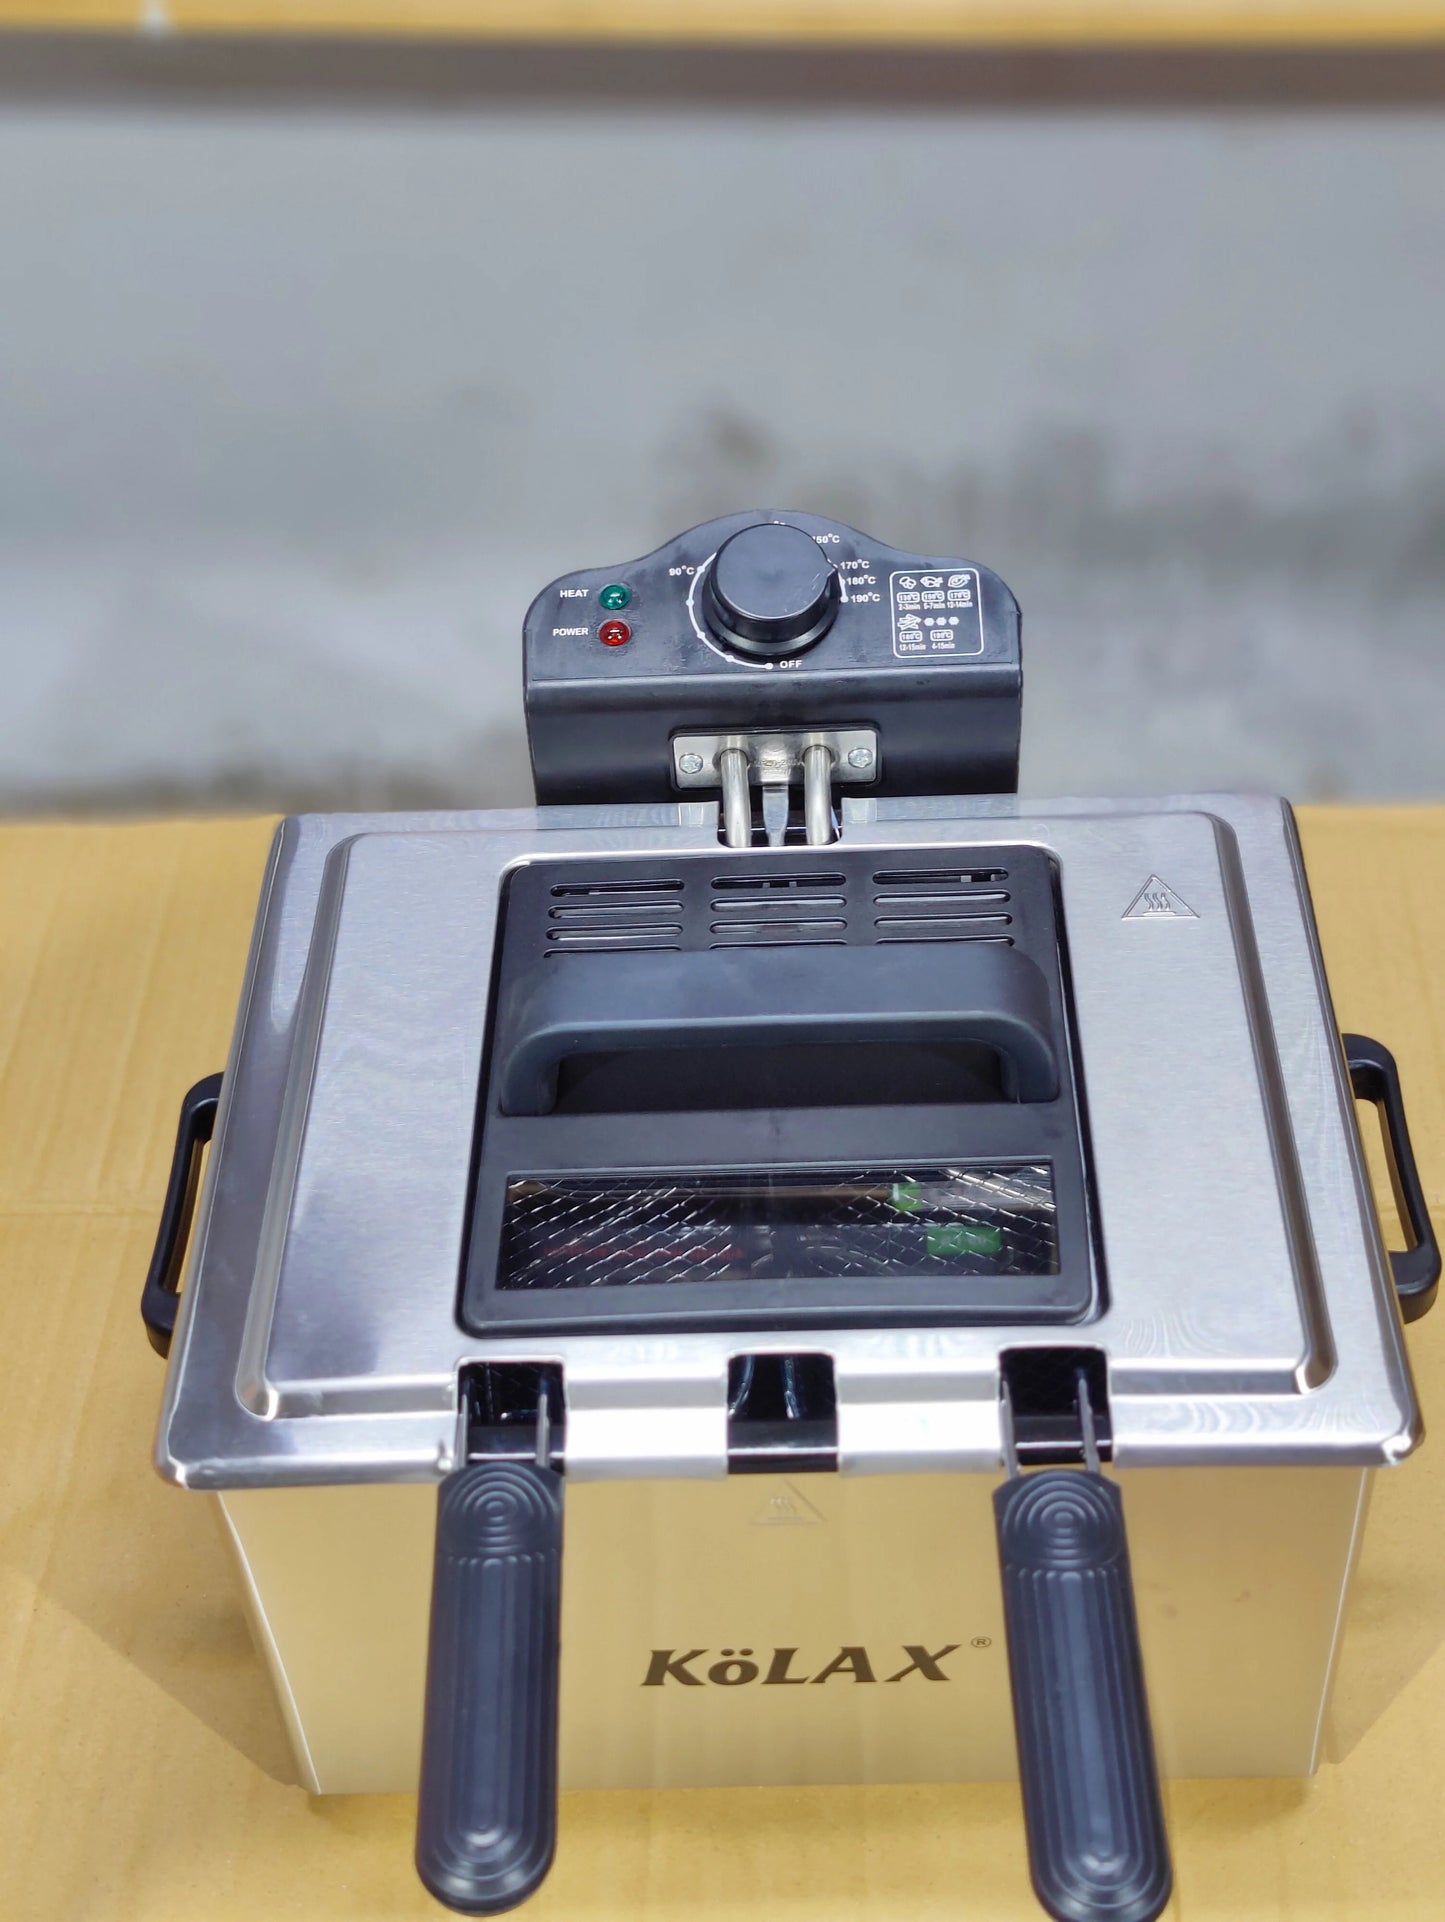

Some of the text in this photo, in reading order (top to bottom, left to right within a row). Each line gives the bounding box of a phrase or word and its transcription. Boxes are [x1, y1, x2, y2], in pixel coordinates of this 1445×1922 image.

[812, 533, 840, 544] 50°C
[840, 559, 870, 569] 170°C
[668, 565, 695, 576] 90°C
[846, 574, 876, 585] 180°C
[559, 589, 590, 598] HEAT
[850, 592, 881, 603] 190°C
[552, 627, 589, 636] POWER
[779, 659, 803, 669] OFF
[641, 1644, 961, 1686] KöLAX
